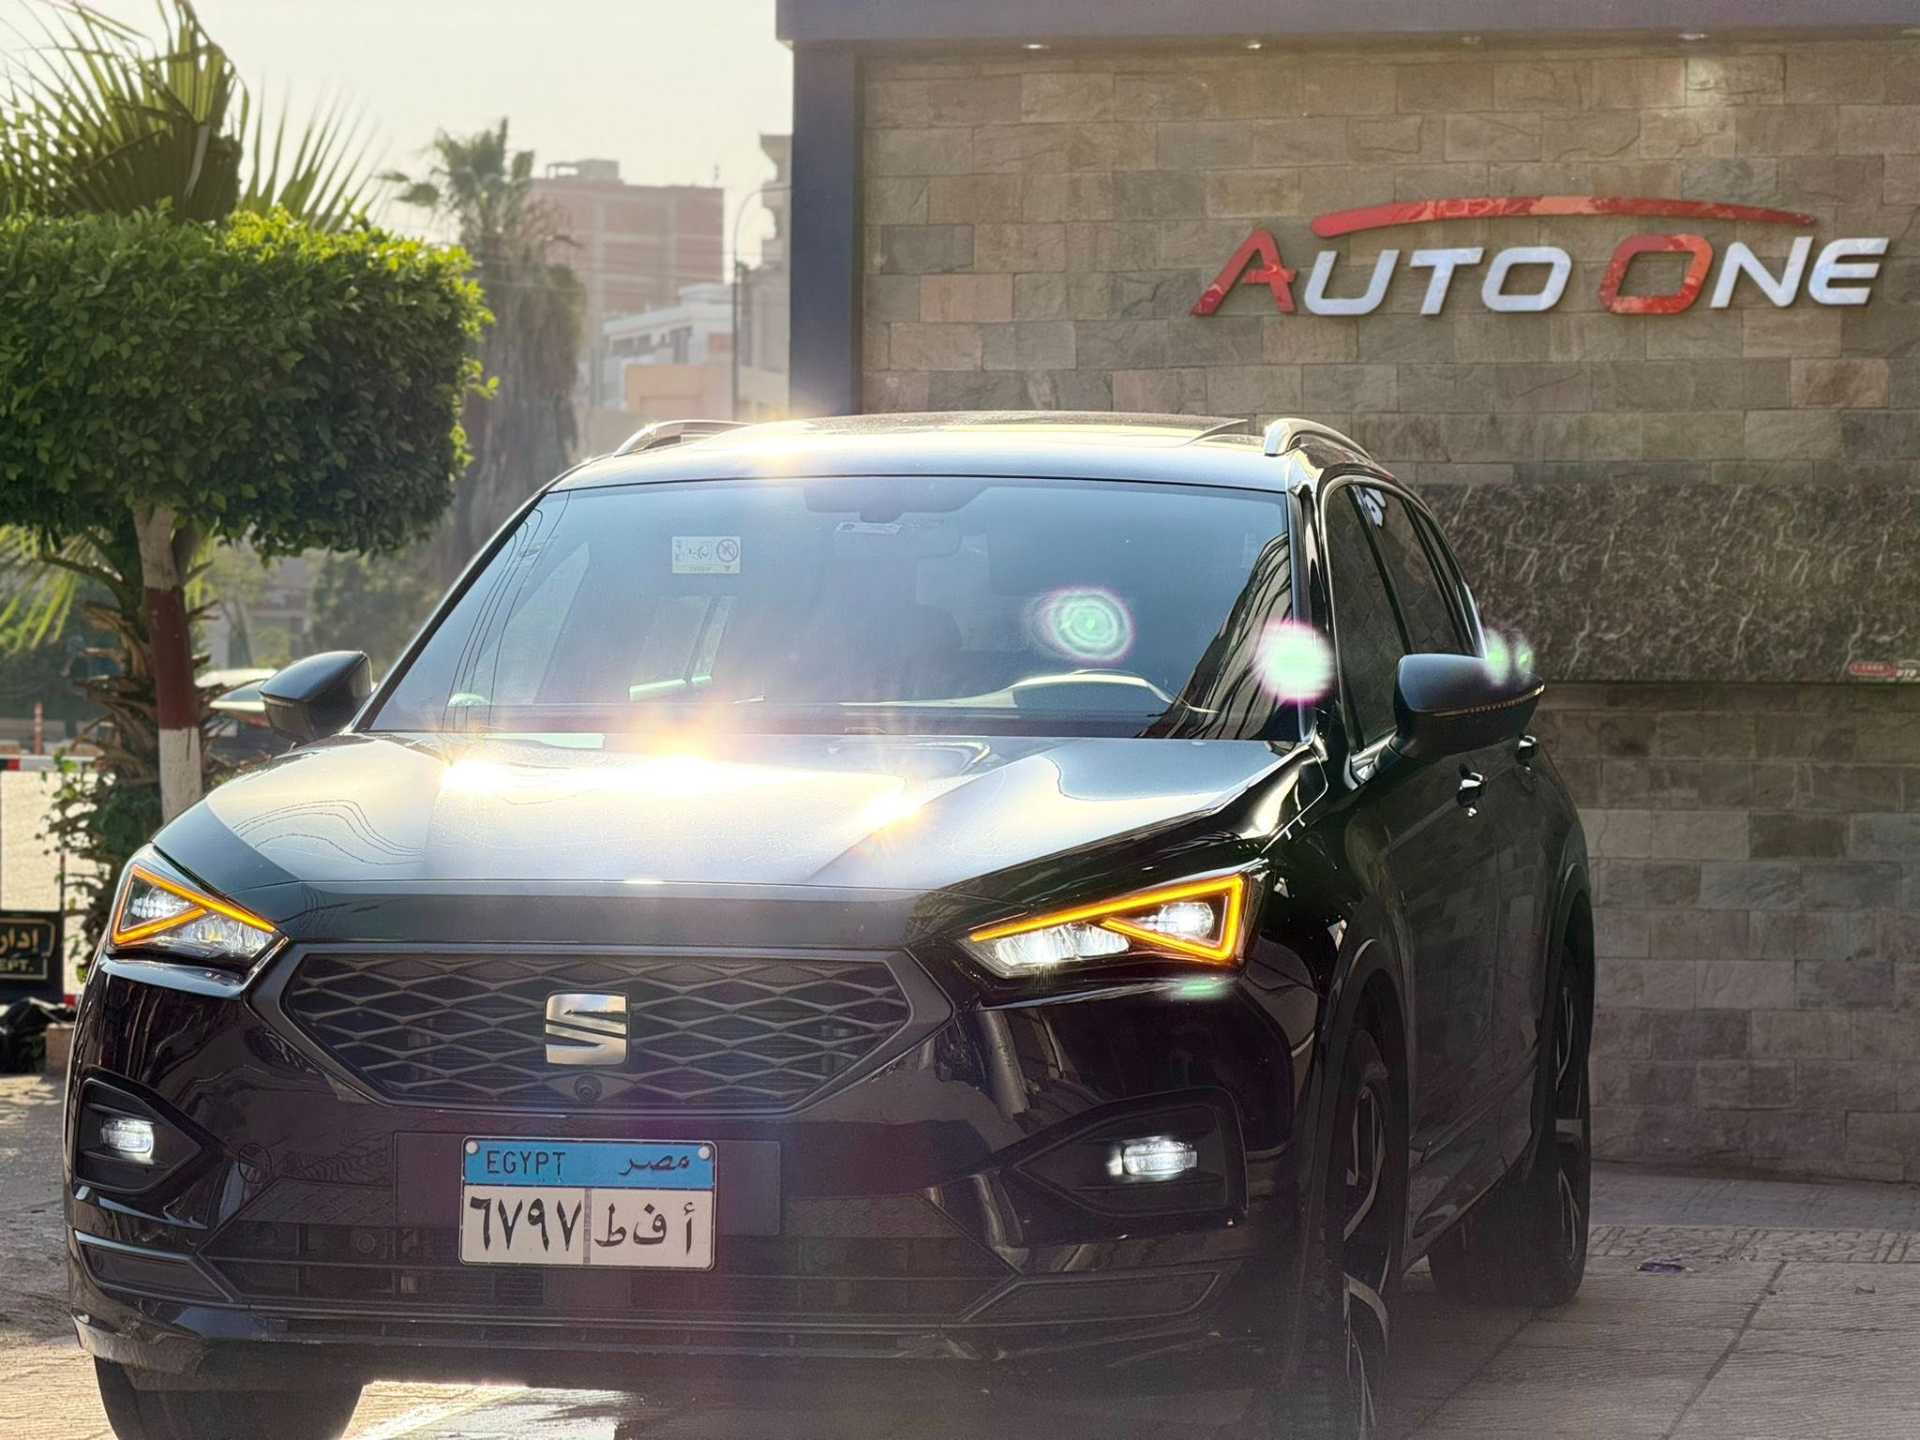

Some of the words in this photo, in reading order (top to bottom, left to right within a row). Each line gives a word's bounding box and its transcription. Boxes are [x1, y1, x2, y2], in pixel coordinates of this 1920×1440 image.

[1190, 228, 1573, 316] AUTO
[1600, 233, 1890, 316] ONE
[486, 1150, 567, 1176] EGYPT
[618, 1153, 691, 1177] مصر
[469, 1196, 583, 1252] ٦٧٩٧
